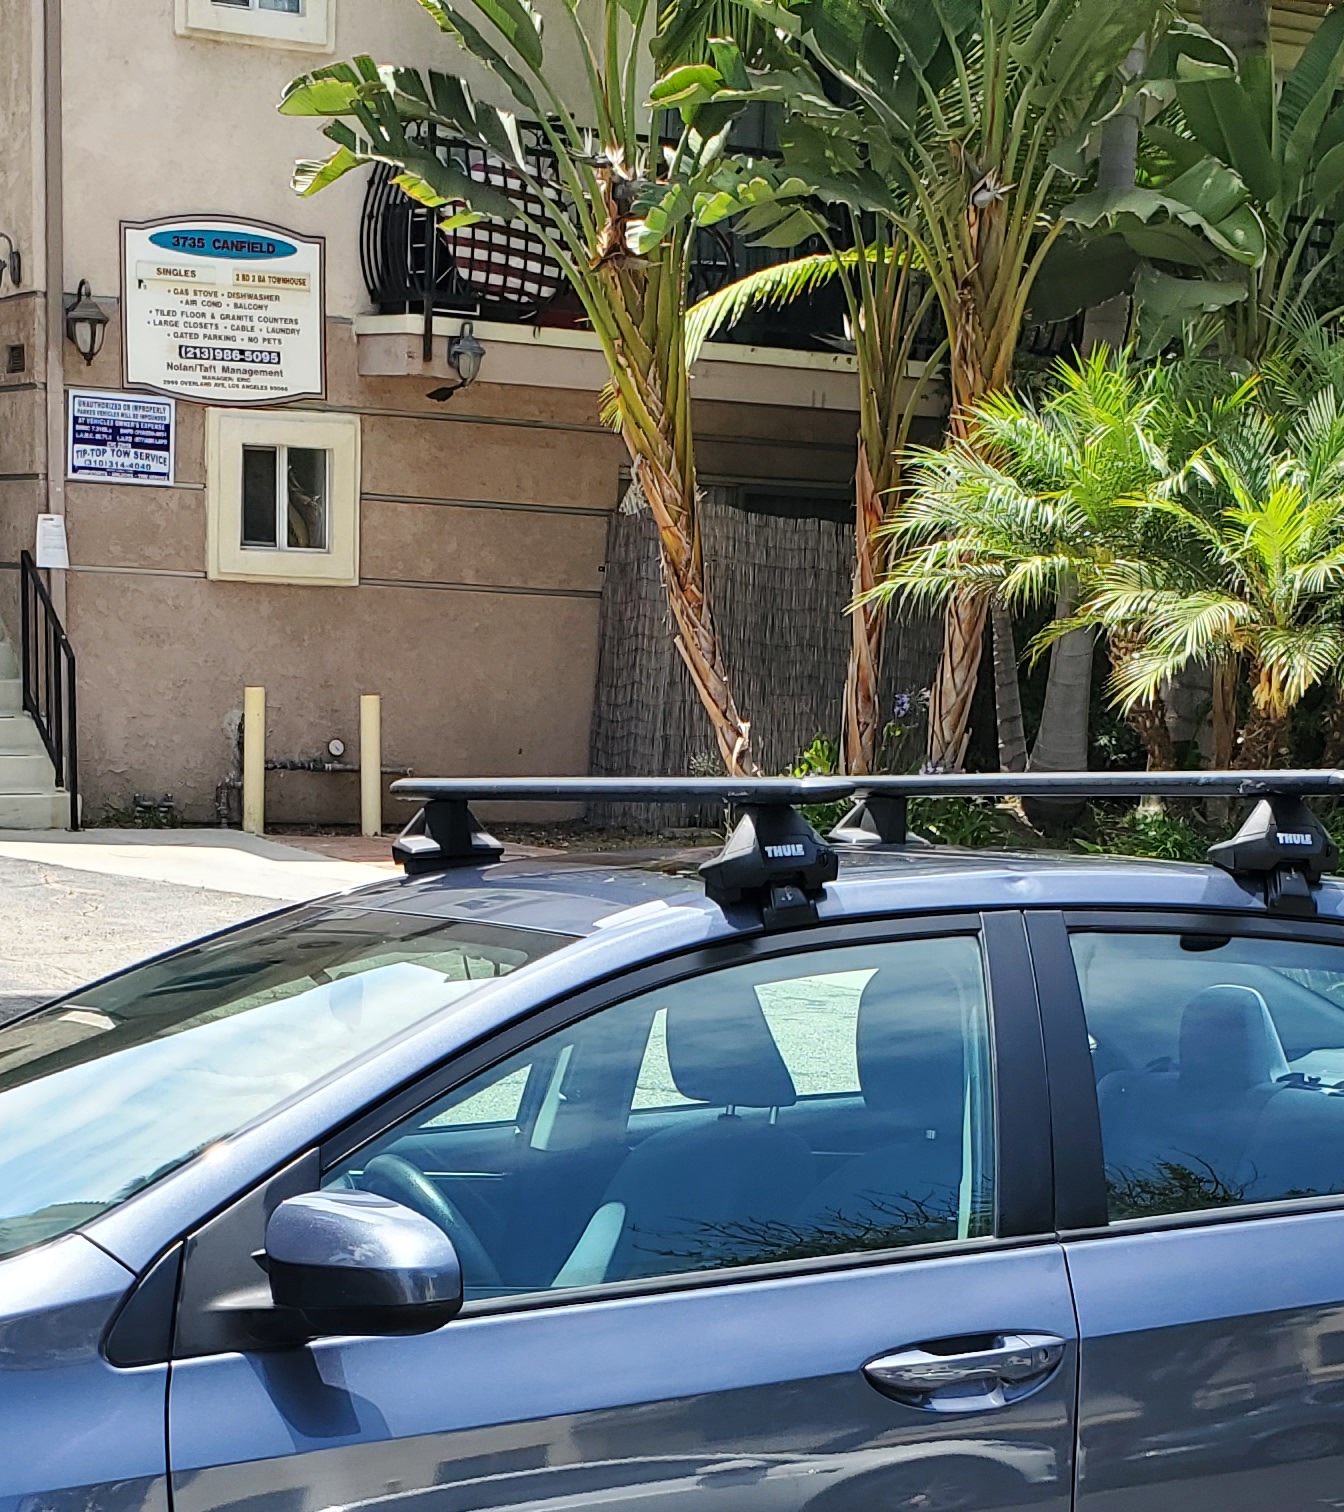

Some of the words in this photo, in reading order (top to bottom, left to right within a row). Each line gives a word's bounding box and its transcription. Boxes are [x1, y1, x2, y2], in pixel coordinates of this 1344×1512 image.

[171, 235, 205, 249] 3735
[212, 238, 276, 254] CANFIELD
[156, 267, 197, 278] SINGLES
[268, 275, 307, 287] TOWNHOUSE
[173, 287, 189, 296] GAS
[193, 289, 218, 298] STOVE
[227, 291, 280, 302] DISHWASHER
[184, 298, 197, 306] AIR
[201, 299, 223, 308] COND
[233, 302, 269, 311] BALCONY
[155, 308, 177, 317] TILED
[180, 310, 206, 319] FLOOR
[210, 312, 216, 320] &
[219, 313, 254, 323] GRANITE
[257, 315, 299, 325] COUNTERS
[153, 319, 180, 328] LARGE
[183, 320, 219, 330] CLOSETS
[230, 324, 256, 333] CABLE
[266, 327, 301, 336] LAUNDRY
[173, 331, 199, 340] GATED
[202, 333, 237, 342] PARKING
[247, 336, 259, 344] NO
[262, 337, 282, 345] PETS
[181, 345, 279, 363] (213)986-5095
[166, 361, 217, 373] Nolan/Taft
[221, 365, 284, 377] Management
[77, 400, 121, 410] UNAUTHORIZED
[122, 403, 130, 411] OR
[131, 404, 166, 414] IMPROPERLY
[84, 459, 152, 471] (310)314-4040
[111, 449, 130, 459] TOW
[133, 450, 168, 466] SERVICE
[1277, 832, 1313, 845] THULE
[764, 843, 805, 858] THULE
